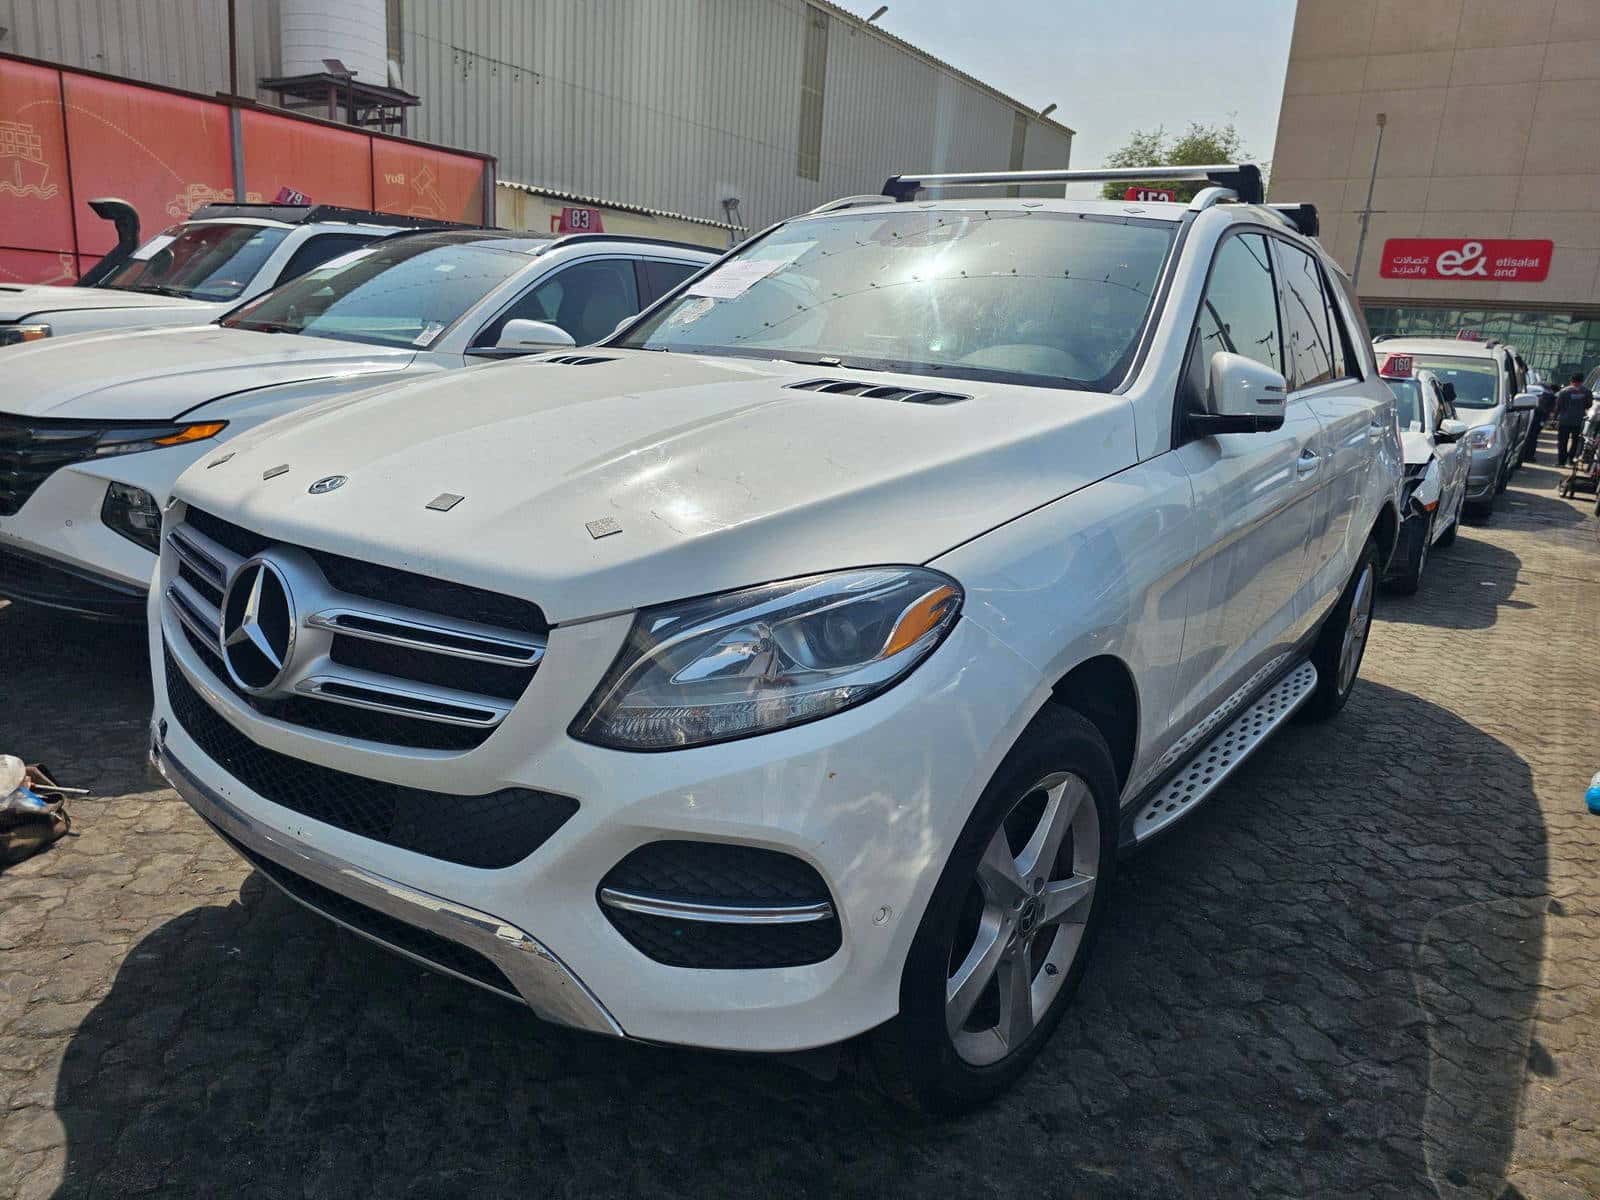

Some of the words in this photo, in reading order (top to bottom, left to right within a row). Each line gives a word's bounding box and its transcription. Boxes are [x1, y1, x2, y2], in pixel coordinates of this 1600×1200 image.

[286, 190, 303, 205] 79
[572, 210, 589, 228] 83
[1393, 256, 1429, 264] اتصالات
[1496, 257, 1539, 267] etisalat
[1494, 268, 1516, 277] and
